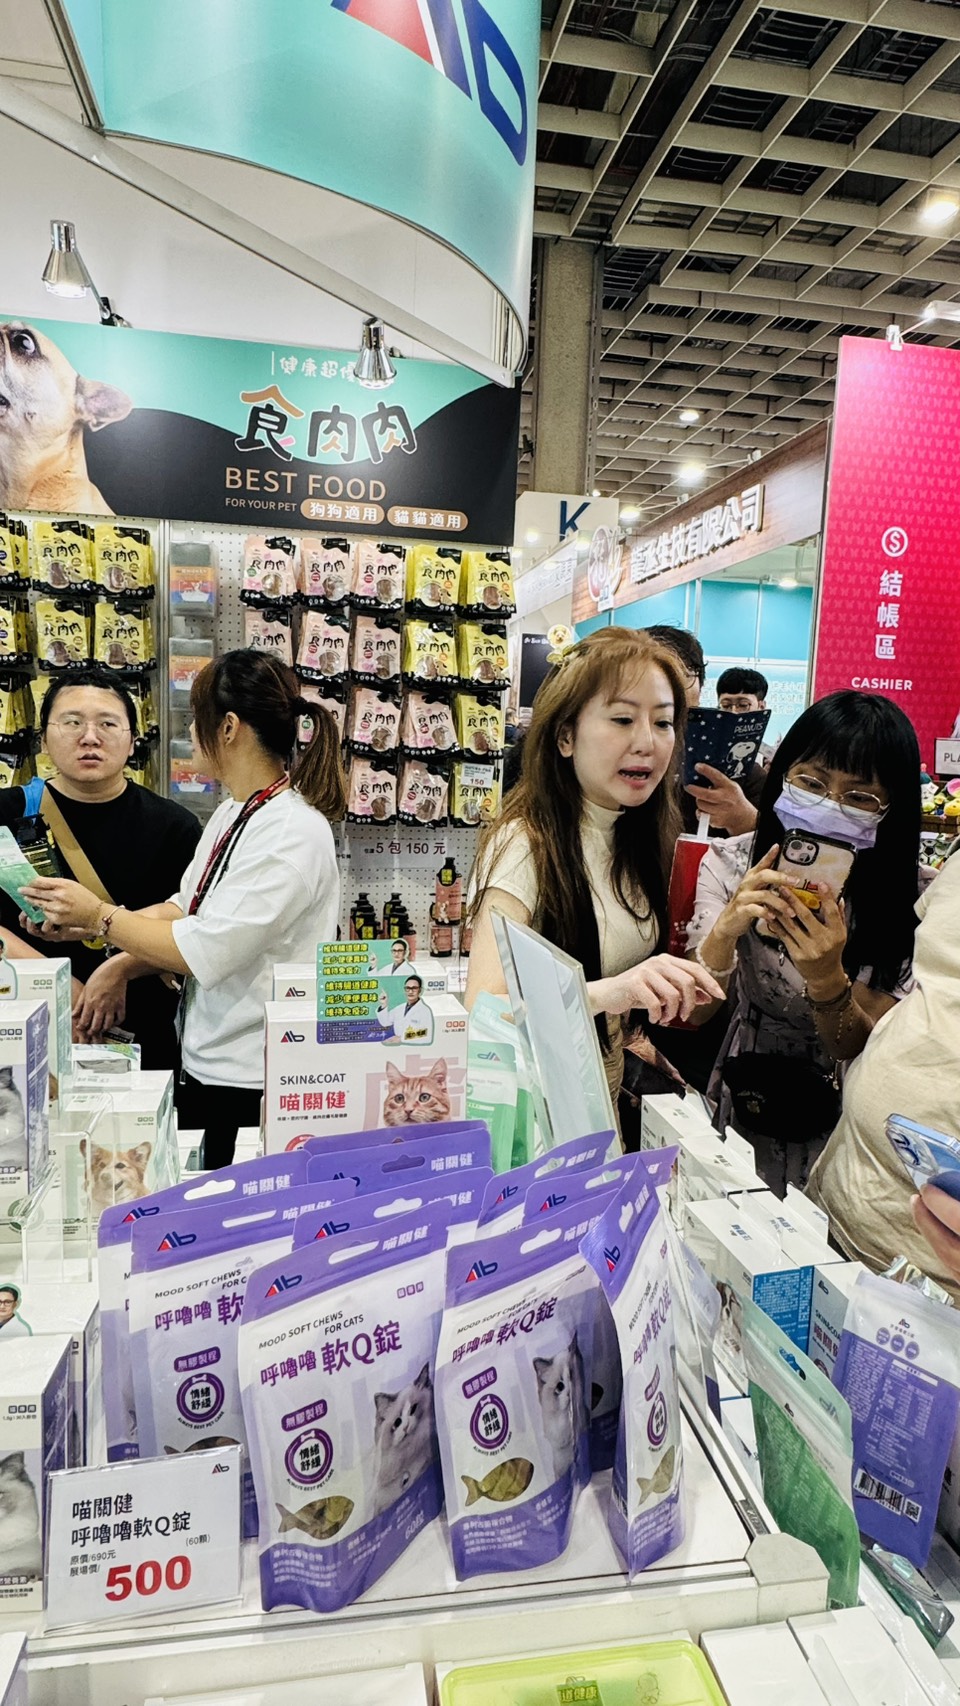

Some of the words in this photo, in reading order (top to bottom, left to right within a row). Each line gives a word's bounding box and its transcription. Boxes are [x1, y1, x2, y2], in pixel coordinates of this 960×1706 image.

[234, 384, 417, 465] 食肉肉
[225, 467, 298, 494] BEST
[307, 474, 387, 501] FOOD
[225, 497, 246, 508] FOR
[248, 499, 276, 511] YOUR
[277, 502, 297, 512] PET
[310, 502, 377, 522] 狗狗適用
[394, 509, 461, 529] 貓貓適用
[560, 500, 590, 541] K
[875, 569, 904, 660] 結帳區
[851, 676, 913, 691] CASHIER
[734, 722, 764, 733] PEANUTS
[470, 778, 484, 786] 150
[376, 842, 384, 854] 5
[388, 841, 402, 855] 包
[406, 843, 429, 854] 150
[433, 842, 446, 855] 元
[325, 980, 378, 992] 維持腸道健康
[325, 993, 378, 1005] 減少便便異味
[325, 1006, 369, 1017] 維持免疫力
[280, 1073, 347, 1086] SKIN&COAT
[280, 1090, 346, 1112] 喵關健
[430, 1152, 473, 1171] 喵關健
[243, 1174, 292, 1195] 喵關健
[382, 1225, 428, 1252] 喵關健
[155, 1286, 183, 1298] MOOD
[186, 1279, 209, 1292] SOFT
[211, 1269, 242, 1285] CHEWS
[221, 1278, 238, 1290] FOR
[259, 1332, 287, 1350] MOOD
[288, 1322, 311, 1338] SOFT
[313, 1310, 344, 1329] CHEWS
[324, 1323, 342, 1336] FOR
[343, 1314, 364, 1328] CATS
[457, 1319, 481, 1335] MOOD
[206, 1420, 216, 1429] PET
[213, 1410, 225, 1423] CARE
[317, 1481, 326, 1490] PET
[72, 1492, 133, 1522] 喵關健
[71, 1511, 192, 1548] 呼嚕嚕軟Q錠
[186, 1533, 211, 1548] (60顆)
[70, 1549, 116, 1566] 原價/690元
[69, 1564, 100, 1578] 展場價/
[105, 1555, 192, 1602] 500
